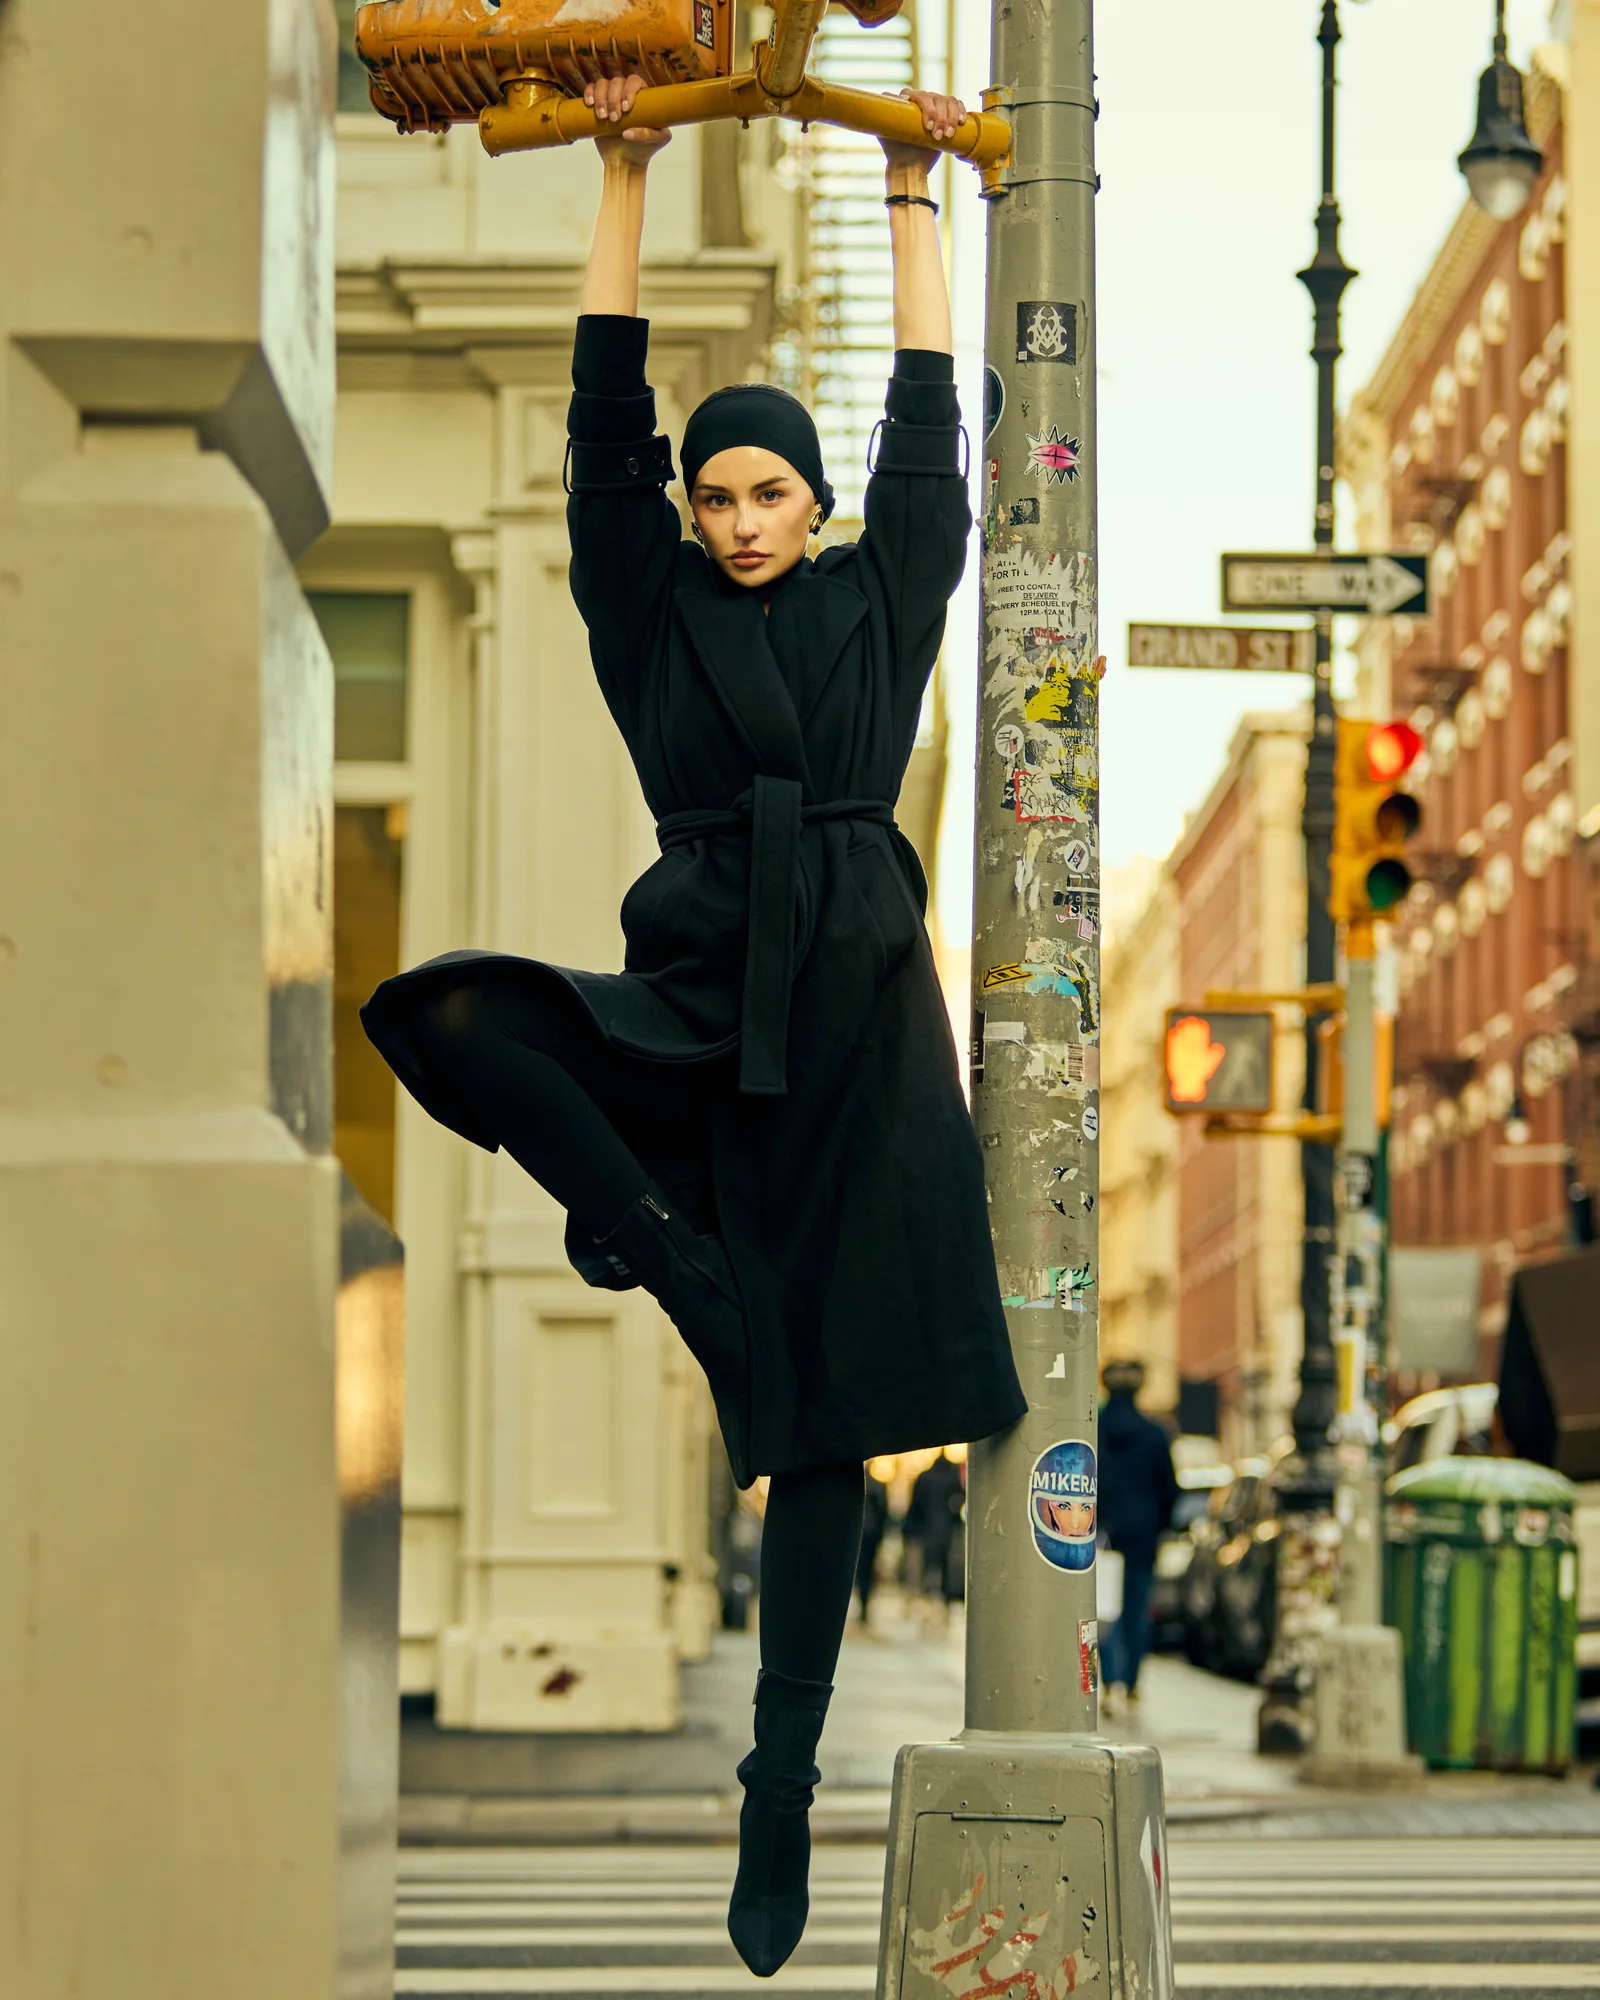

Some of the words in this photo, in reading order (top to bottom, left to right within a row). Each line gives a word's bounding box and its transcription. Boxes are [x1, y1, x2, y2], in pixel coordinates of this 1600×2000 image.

[992, 570, 1008, 580] FOR
[998, 586, 1014, 594] FREE
[1026, 583, 1061, 591] CONTAT
[1132, 627, 1238, 668] GRAND
[1248, 632, 1291, 669] ST
